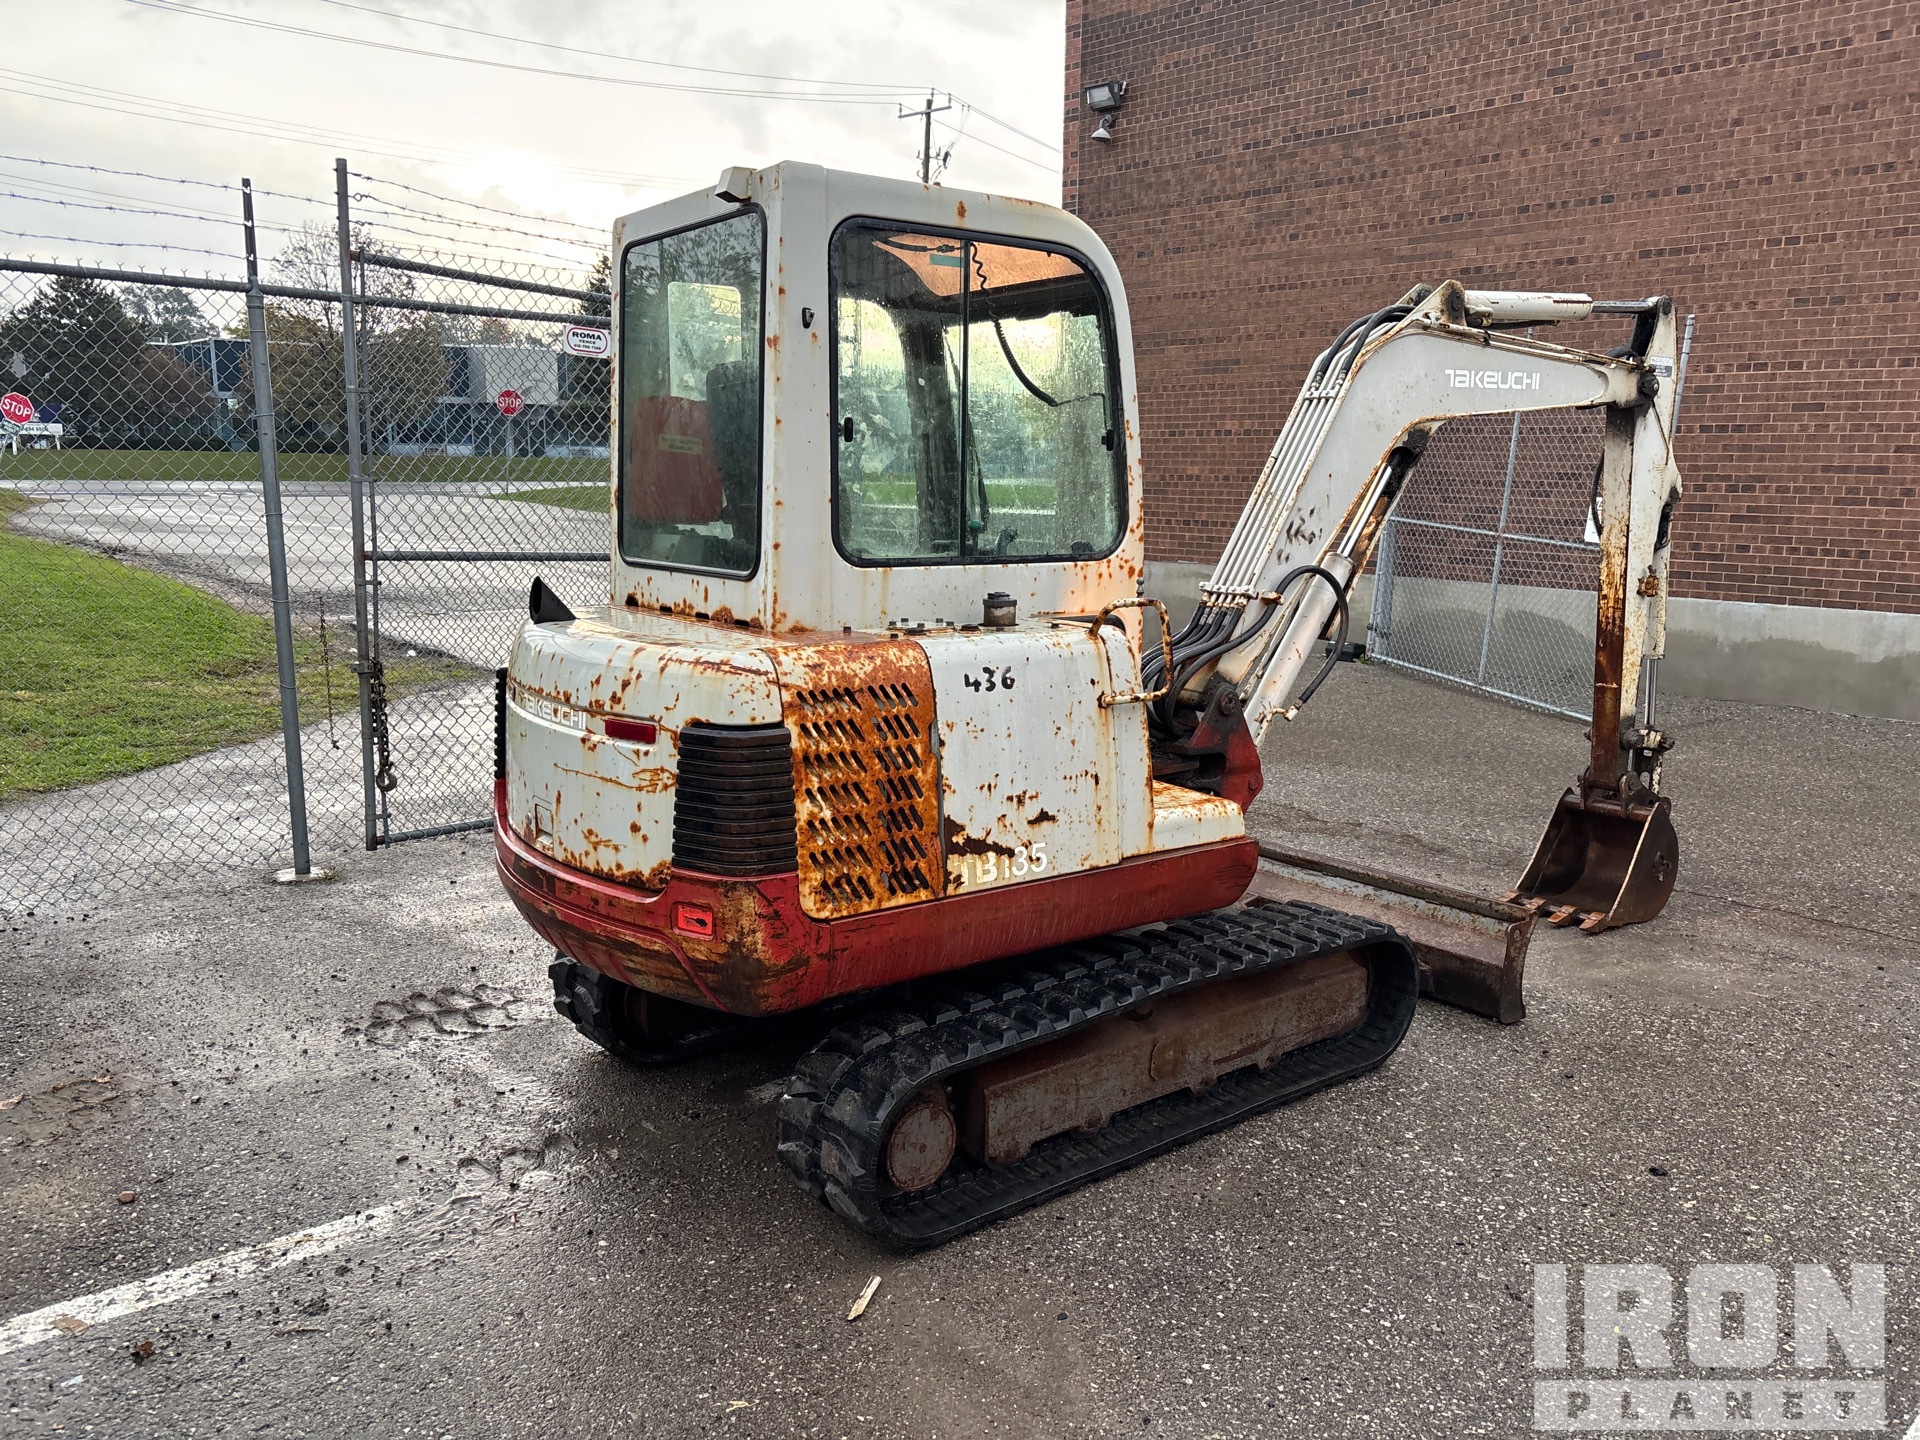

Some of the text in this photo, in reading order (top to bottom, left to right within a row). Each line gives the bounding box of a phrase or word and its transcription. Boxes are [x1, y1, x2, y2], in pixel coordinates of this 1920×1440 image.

[572, 331, 602, 341] ROMA
[1444, 369, 1540, 390] TAKEUCHI
[2, 398, 32, 418] STOP
[499, 397, 522, 408] STOP
[963, 665, 1016, 693] 436
